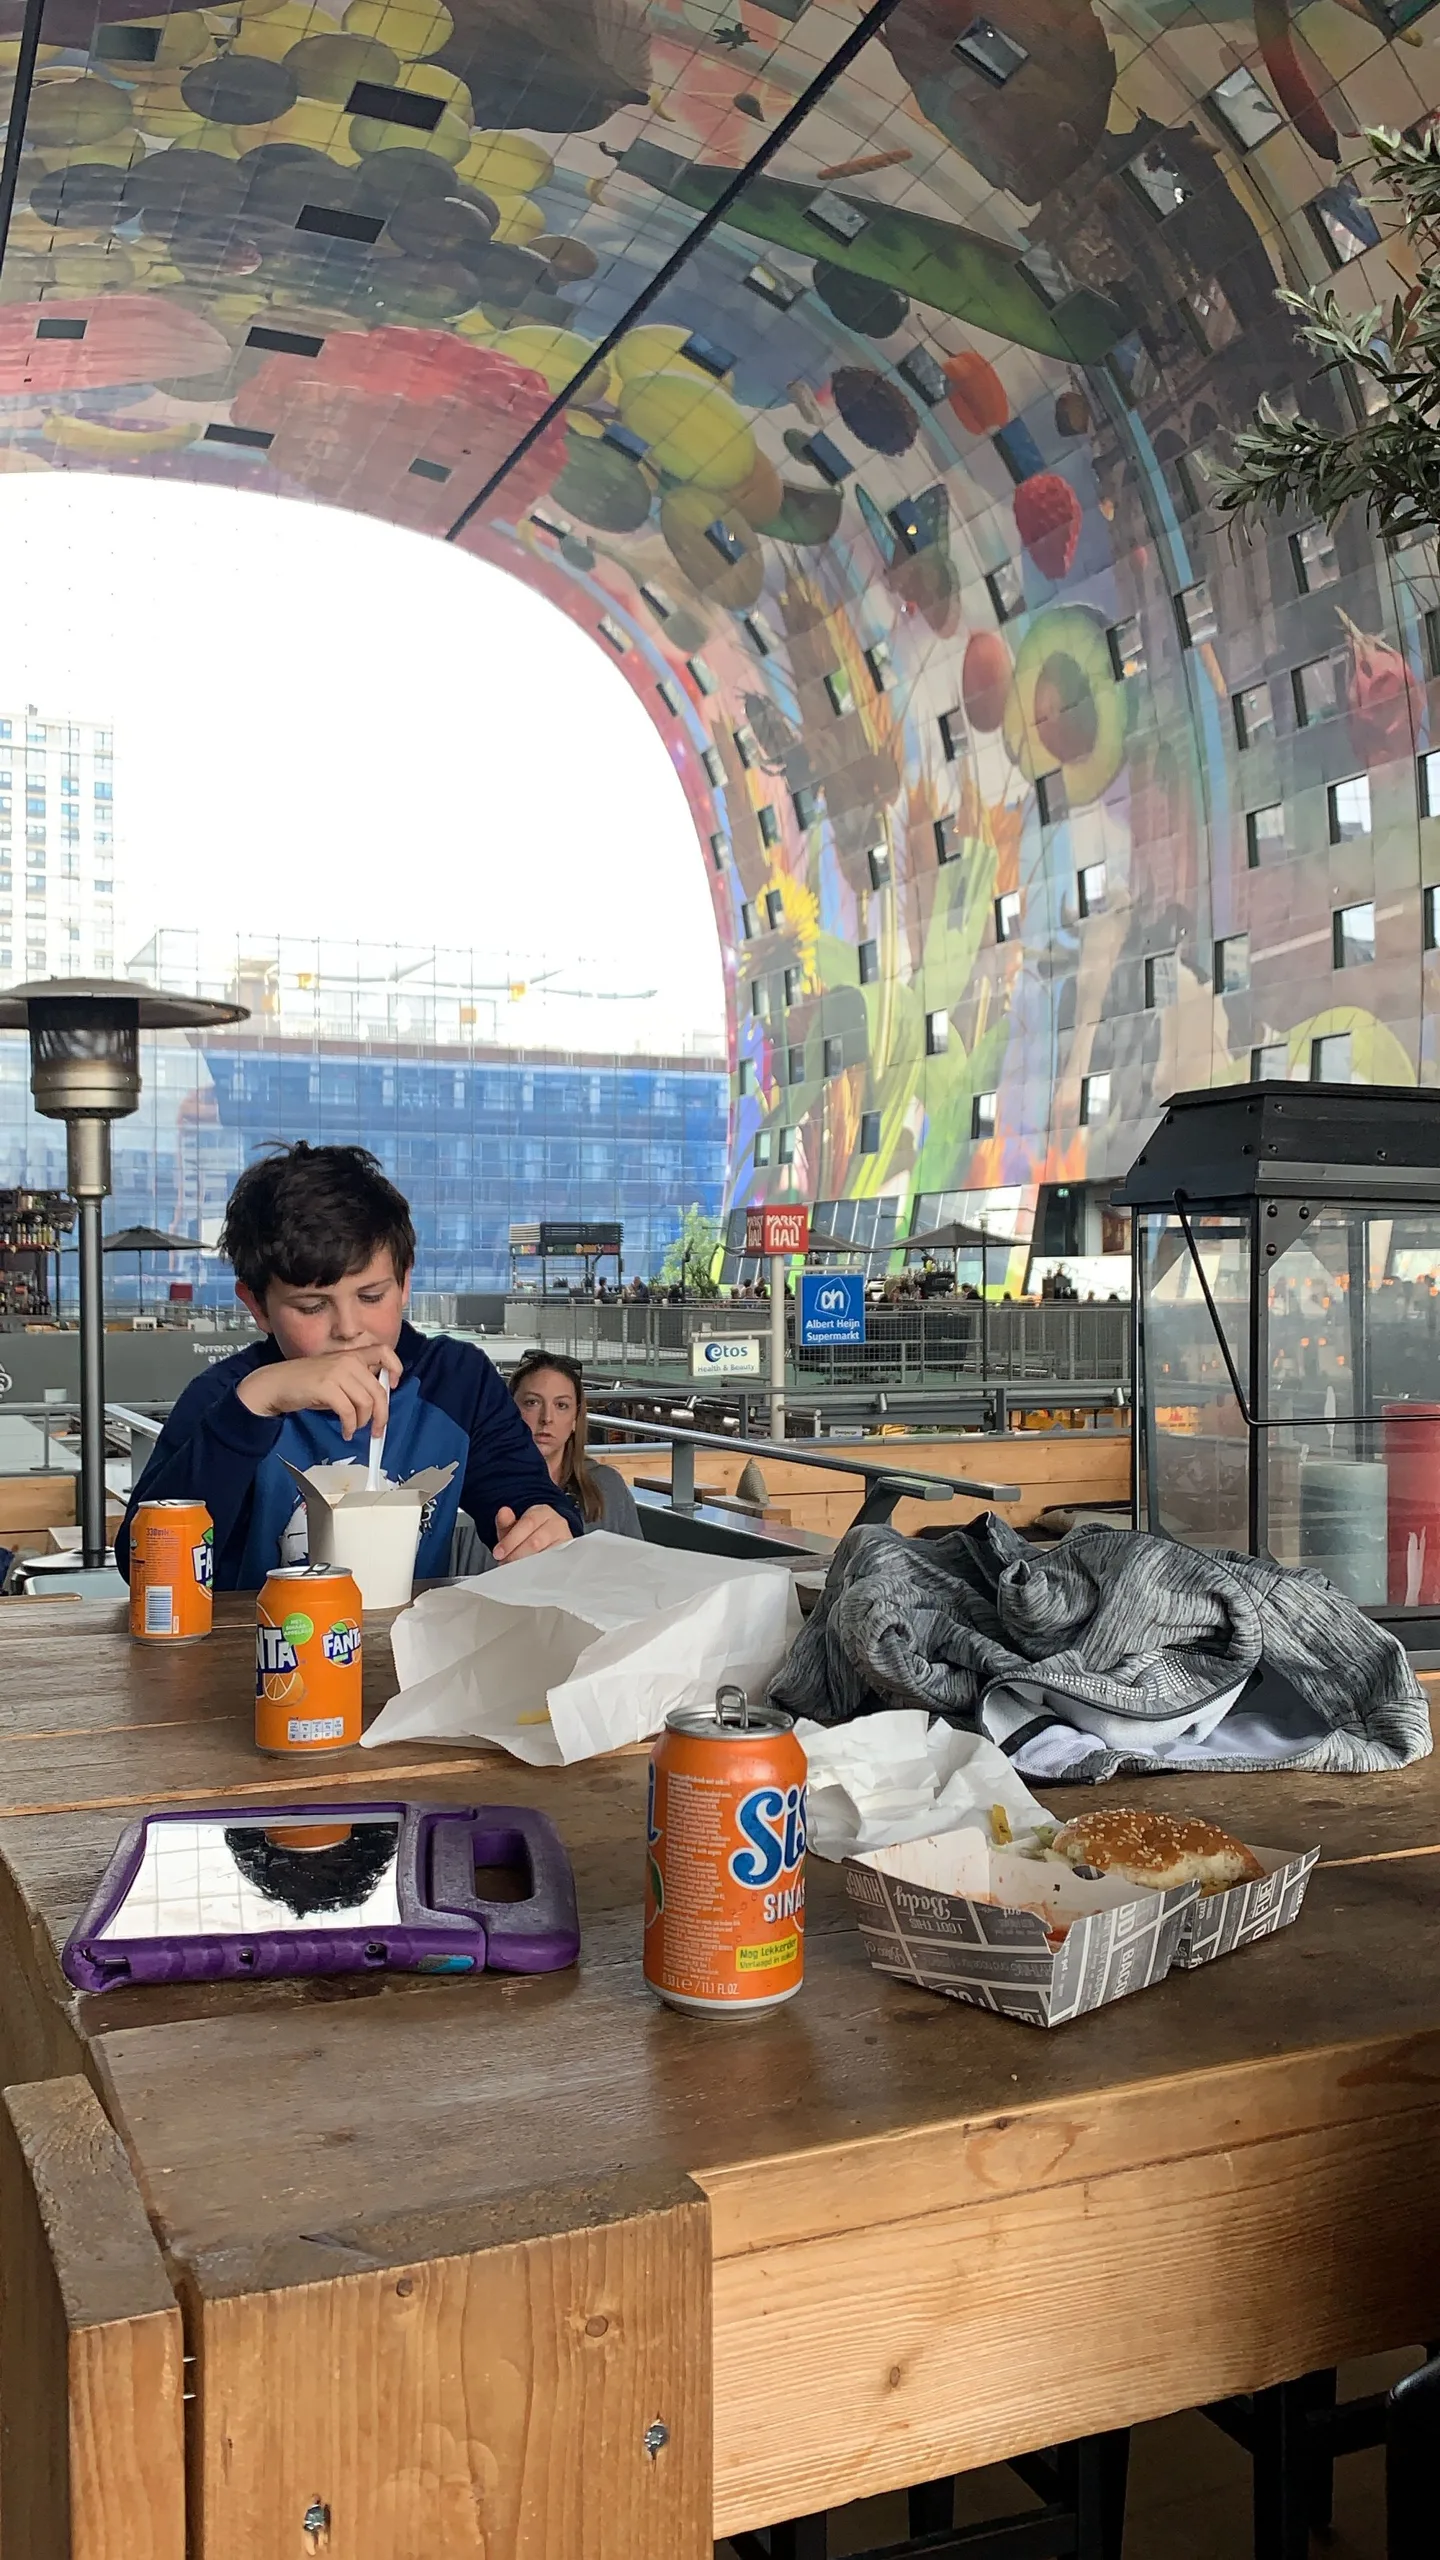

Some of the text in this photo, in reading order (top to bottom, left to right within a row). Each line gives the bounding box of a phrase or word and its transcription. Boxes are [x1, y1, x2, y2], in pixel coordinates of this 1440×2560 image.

[766, 1215, 804, 1227] MARKT
[771, 1222, 799, 1247] HAL
[805, 1318, 860, 1330] Albert Heijn
[806, 1330, 860, 1343] Supermarkt
[193, 1342, 234, 1354] Terrace
[697, 1364, 721, 1372] Health
[730, 1363, 755, 1372] Beauty
[893, 1886, 950, 1920] Body
[909, 1918, 934, 1931] THIS
